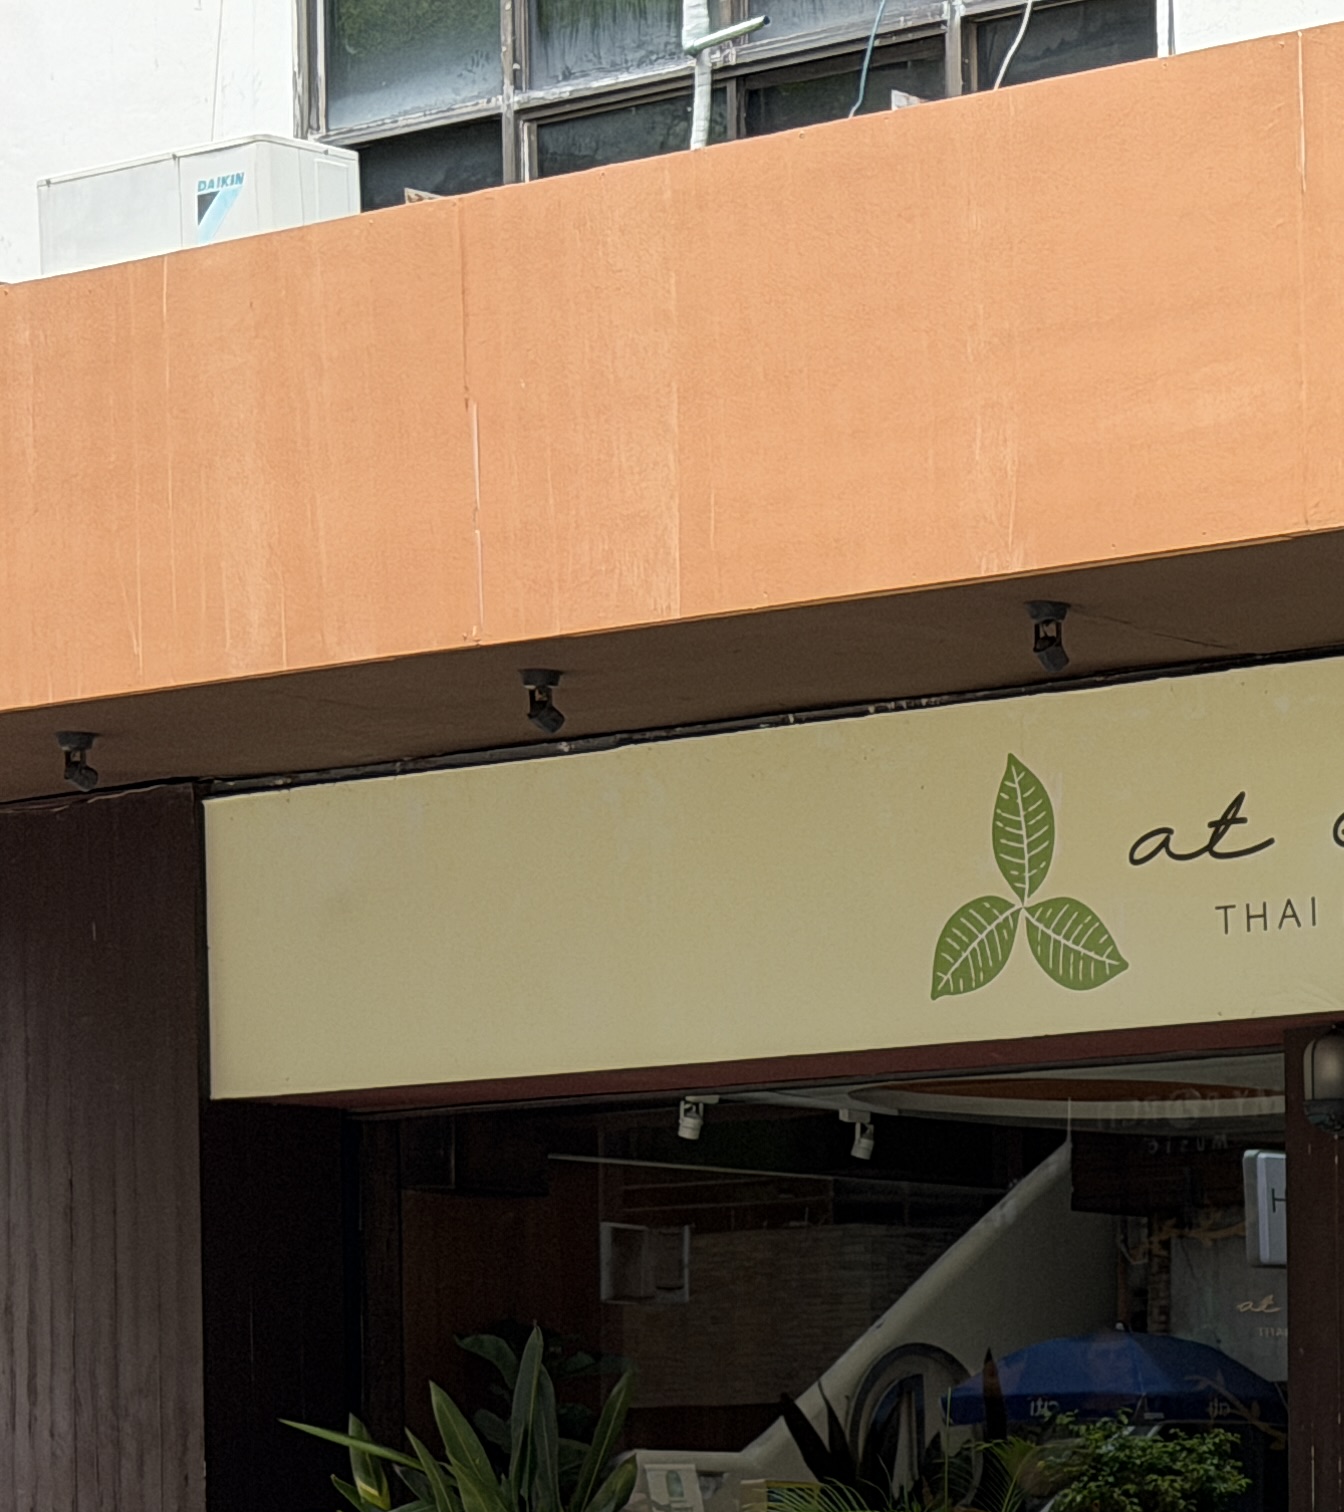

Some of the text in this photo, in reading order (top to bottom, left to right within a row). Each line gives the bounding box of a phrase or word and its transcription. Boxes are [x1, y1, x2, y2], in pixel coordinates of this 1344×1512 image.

[196, 171, 245, 192] DAIKIN
[1128, 791, 1276, 867] at
[1214, 894, 1319, 936] THAI
